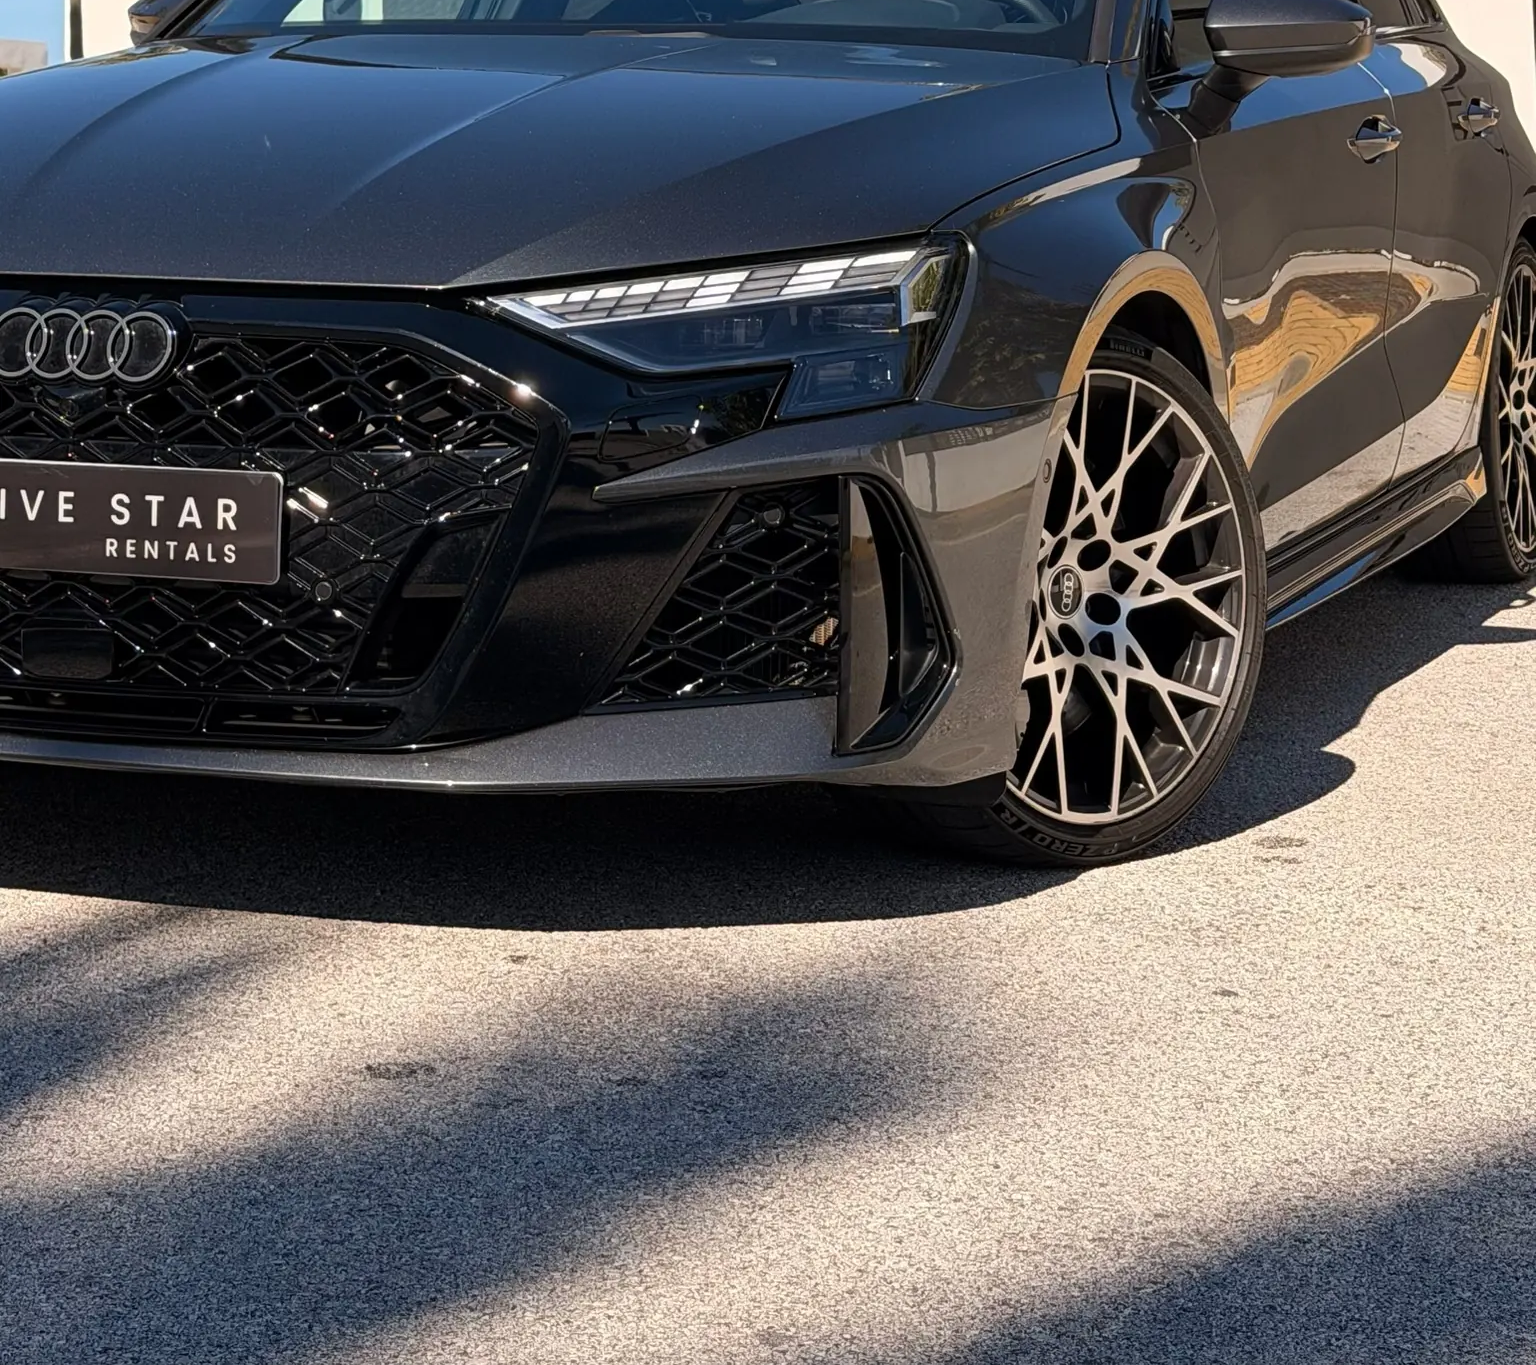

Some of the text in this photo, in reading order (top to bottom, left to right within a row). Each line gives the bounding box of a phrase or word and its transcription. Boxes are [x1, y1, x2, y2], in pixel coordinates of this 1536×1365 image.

[0, 488, 237, 531] IVE STAR
[105, 538, 236, 564] RENTALS
[1000, 808, 1017, 825] R
[1032, 834, 1097, 857] ZERO
